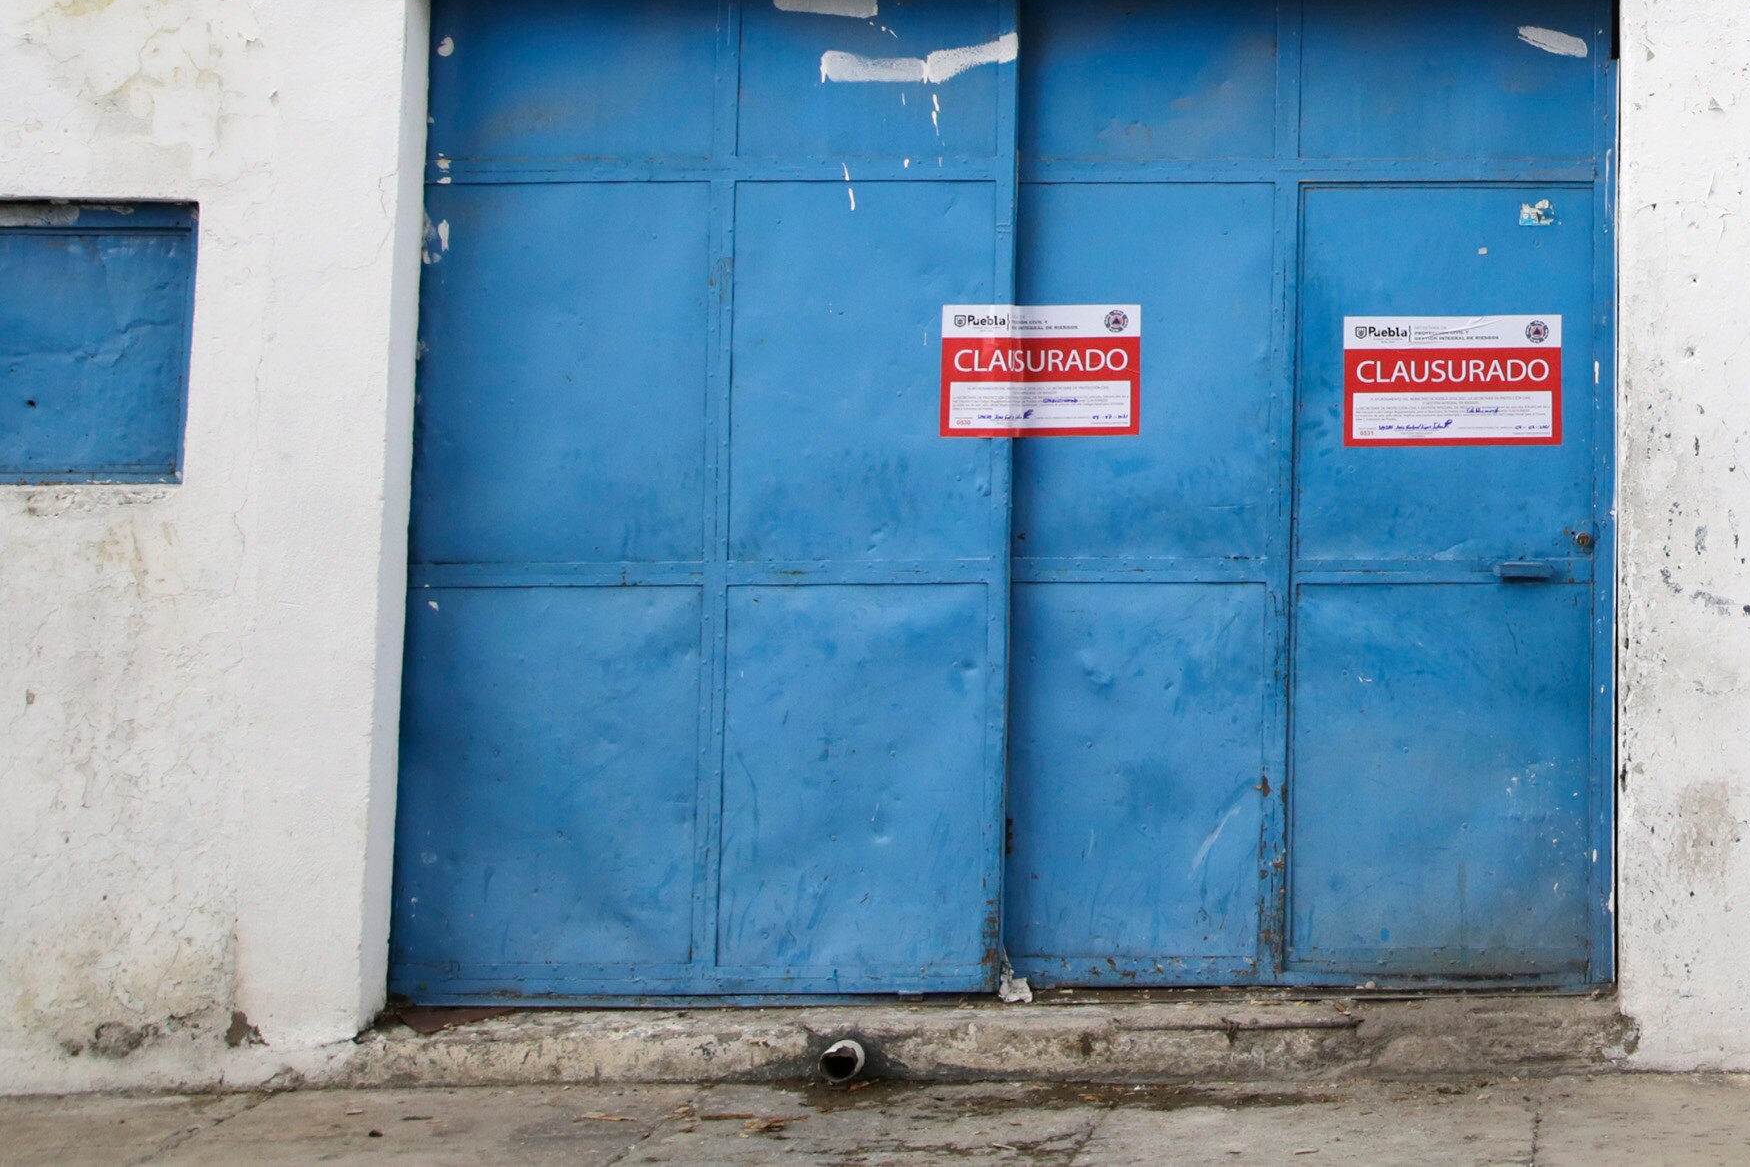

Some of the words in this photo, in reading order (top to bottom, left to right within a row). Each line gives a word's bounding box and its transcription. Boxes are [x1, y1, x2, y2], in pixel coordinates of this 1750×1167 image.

[967, 314, 1006, 327] Puebla
[1368, 325, 1408, 338] Puebla
[1356, 358, 1550, 384] CLAUSURADO
